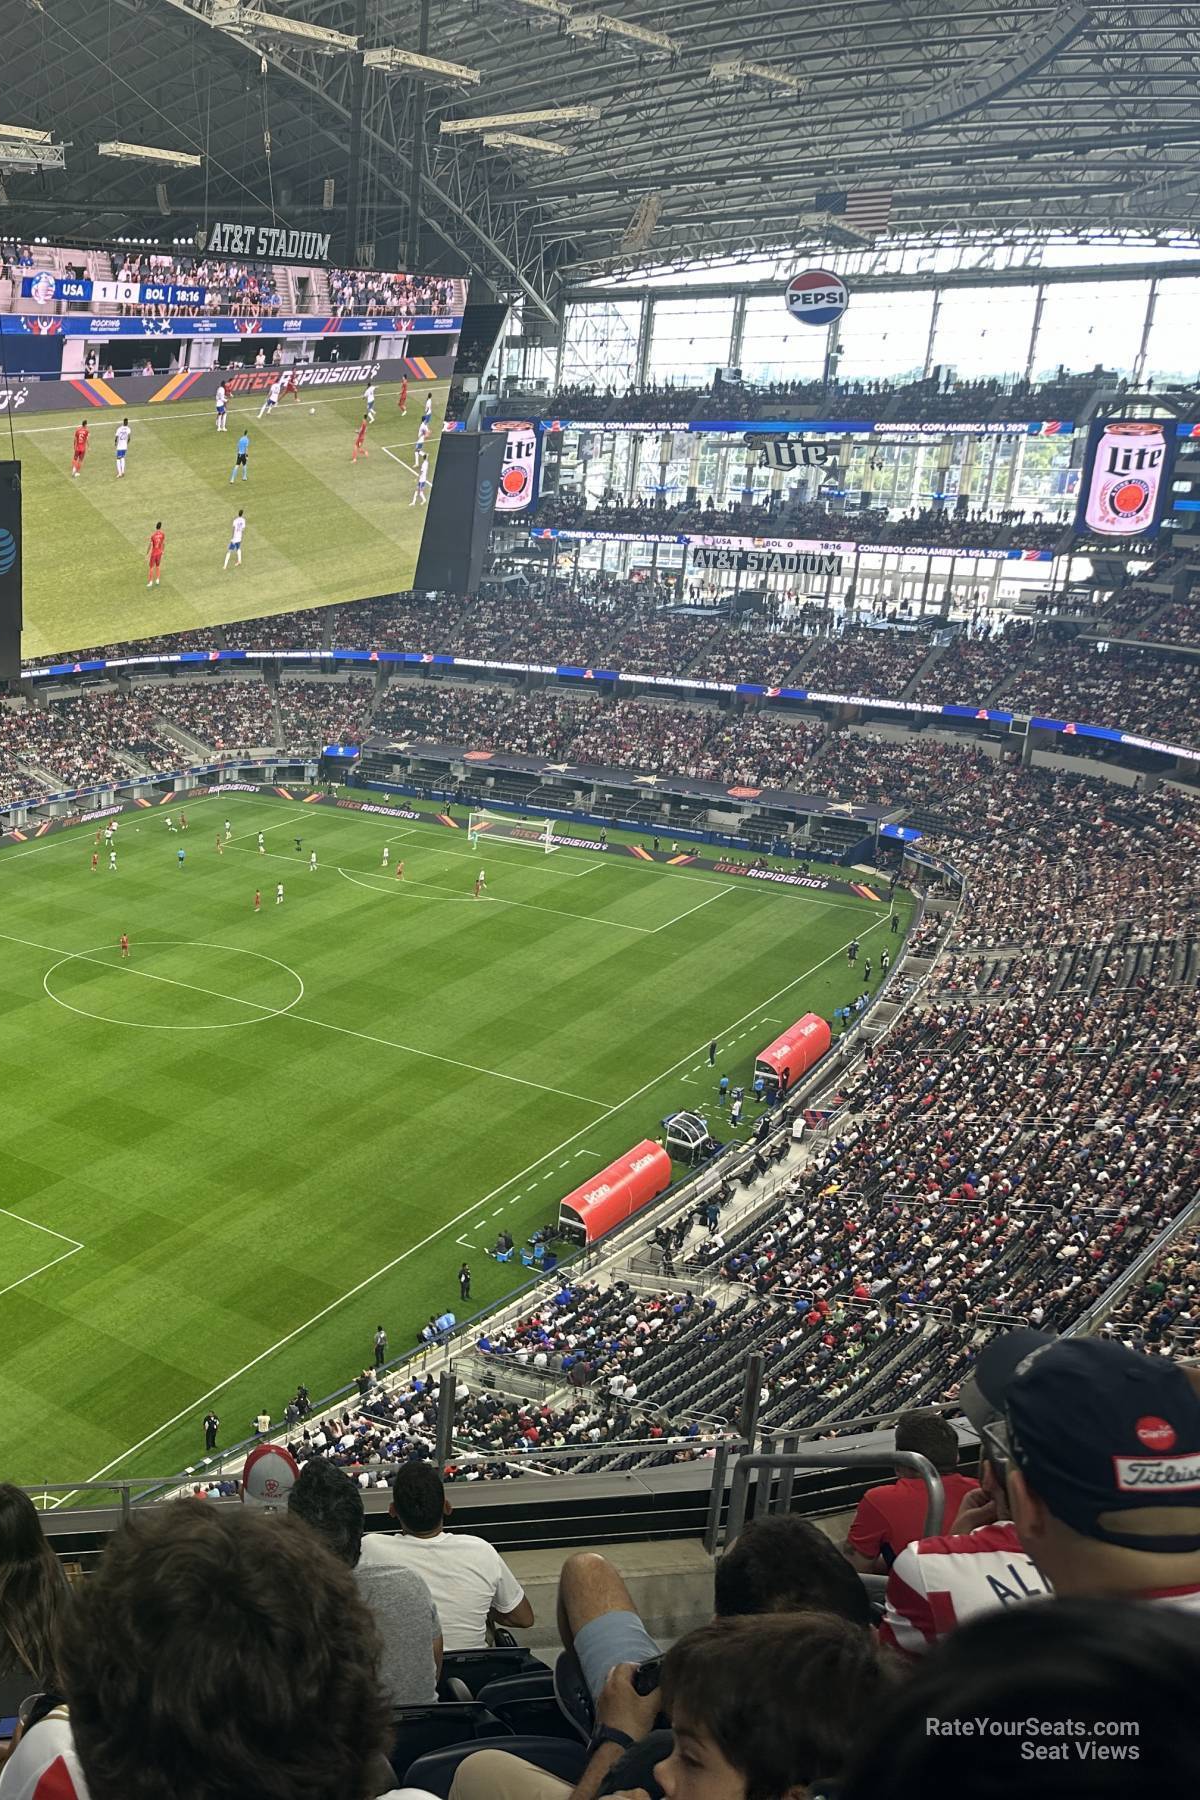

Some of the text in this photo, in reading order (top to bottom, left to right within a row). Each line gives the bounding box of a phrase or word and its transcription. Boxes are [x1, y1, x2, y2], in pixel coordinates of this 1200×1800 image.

[207, 222, 331, 260] AT&T STADIUM
[62, 284, 199, 302] USA 1 0 BOL 18:16
[789, 292, 844, 305] PEPSI
[568, 422, 689, 430] CONMEBOL COPA AMERICA USA 2024
[764, 441, 826, 471] Lite
[1104, 446, 1162, 477] Lite
[596, 532, 614, 540] COPA
[614, 533, 645, 541] AMERICA
[860, 545, 1010, 558] CONMEBOL COPA AMERICA USA 2024
[692, 550, 840, 575] AT&T STADIUM
[619, 673, 655, 684] CONMEBOL
[656, 677, 674, 686] COPA
[674, 678, 704, 688] AMERICA
[807, 693, 943, 713] CONMEBOL COPA AMERICA USA 2024
[336, 800, 415, 819] INTER RAPIDISIMO
[714, 863, 821, 888] INTER RAPIDISIMO
